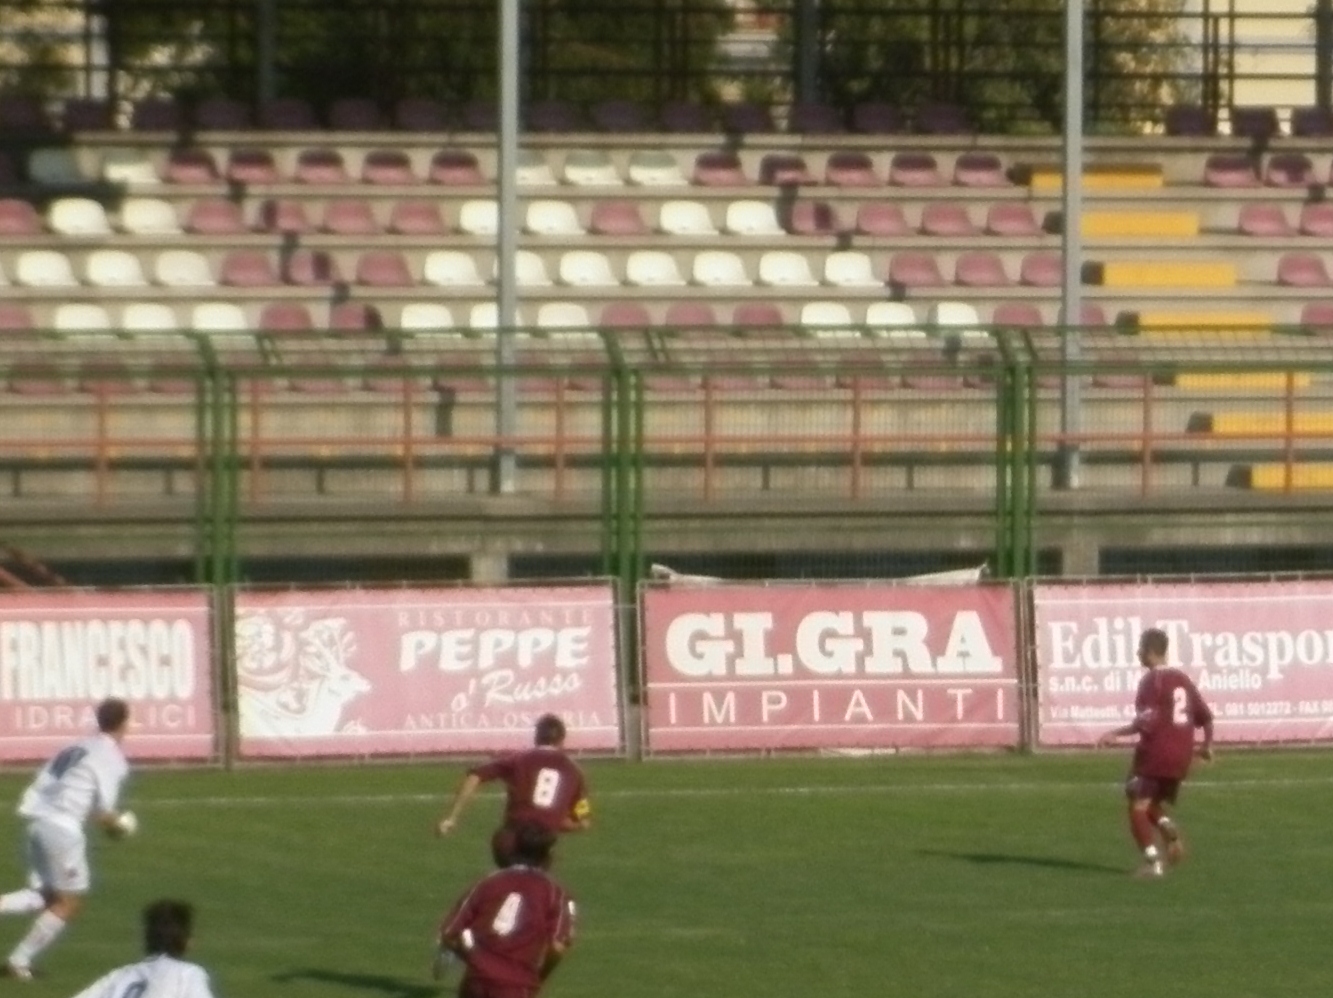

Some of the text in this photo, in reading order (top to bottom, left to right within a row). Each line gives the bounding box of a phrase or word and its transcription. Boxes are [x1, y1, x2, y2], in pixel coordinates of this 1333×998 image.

[400, 610, 593, 626] RISTORANTE
[400, 626, 592, 672] PEPPE
[665, 610, 1003, 676] GI.GRA
[1048, 616, 1142, 669] Edil
[1104, 671, 1121, 690] di
[1198, 669, 1262, 691] Aniello
[14, 704, 196, 730] IDRALICI
[404, 712, 490, 728] ANTICA
[669, 688, 1004, 724] IMPIANTI
[1172, 687, 1189, 726] 2
[533, 766, 561, 809] 8
